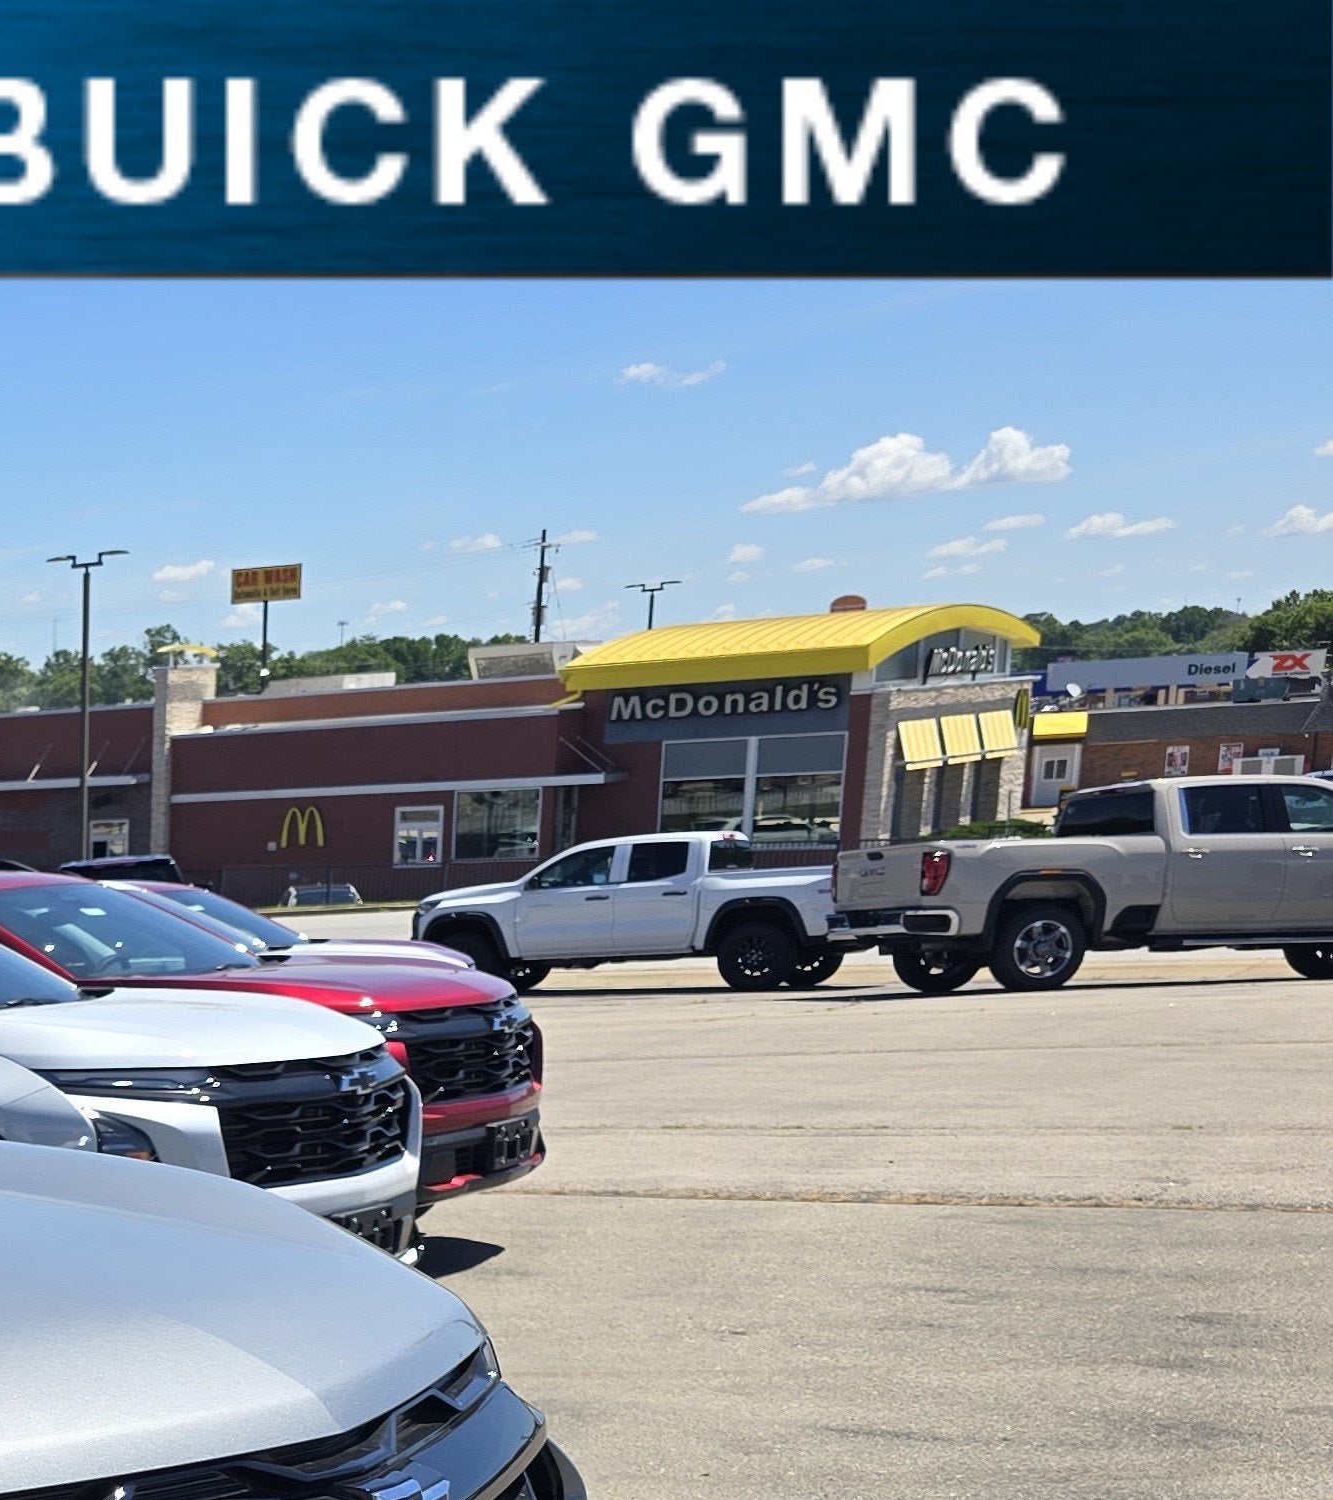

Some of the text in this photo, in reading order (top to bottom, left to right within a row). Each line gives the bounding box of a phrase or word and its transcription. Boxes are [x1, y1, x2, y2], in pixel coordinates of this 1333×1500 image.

[235, 567, 298, 588] CAR WASH
[1187, 662, 1236, 676] Diesel
[1270, 653, 1313, 672] ZX
[608, 682, 839, 722] McDonald's
